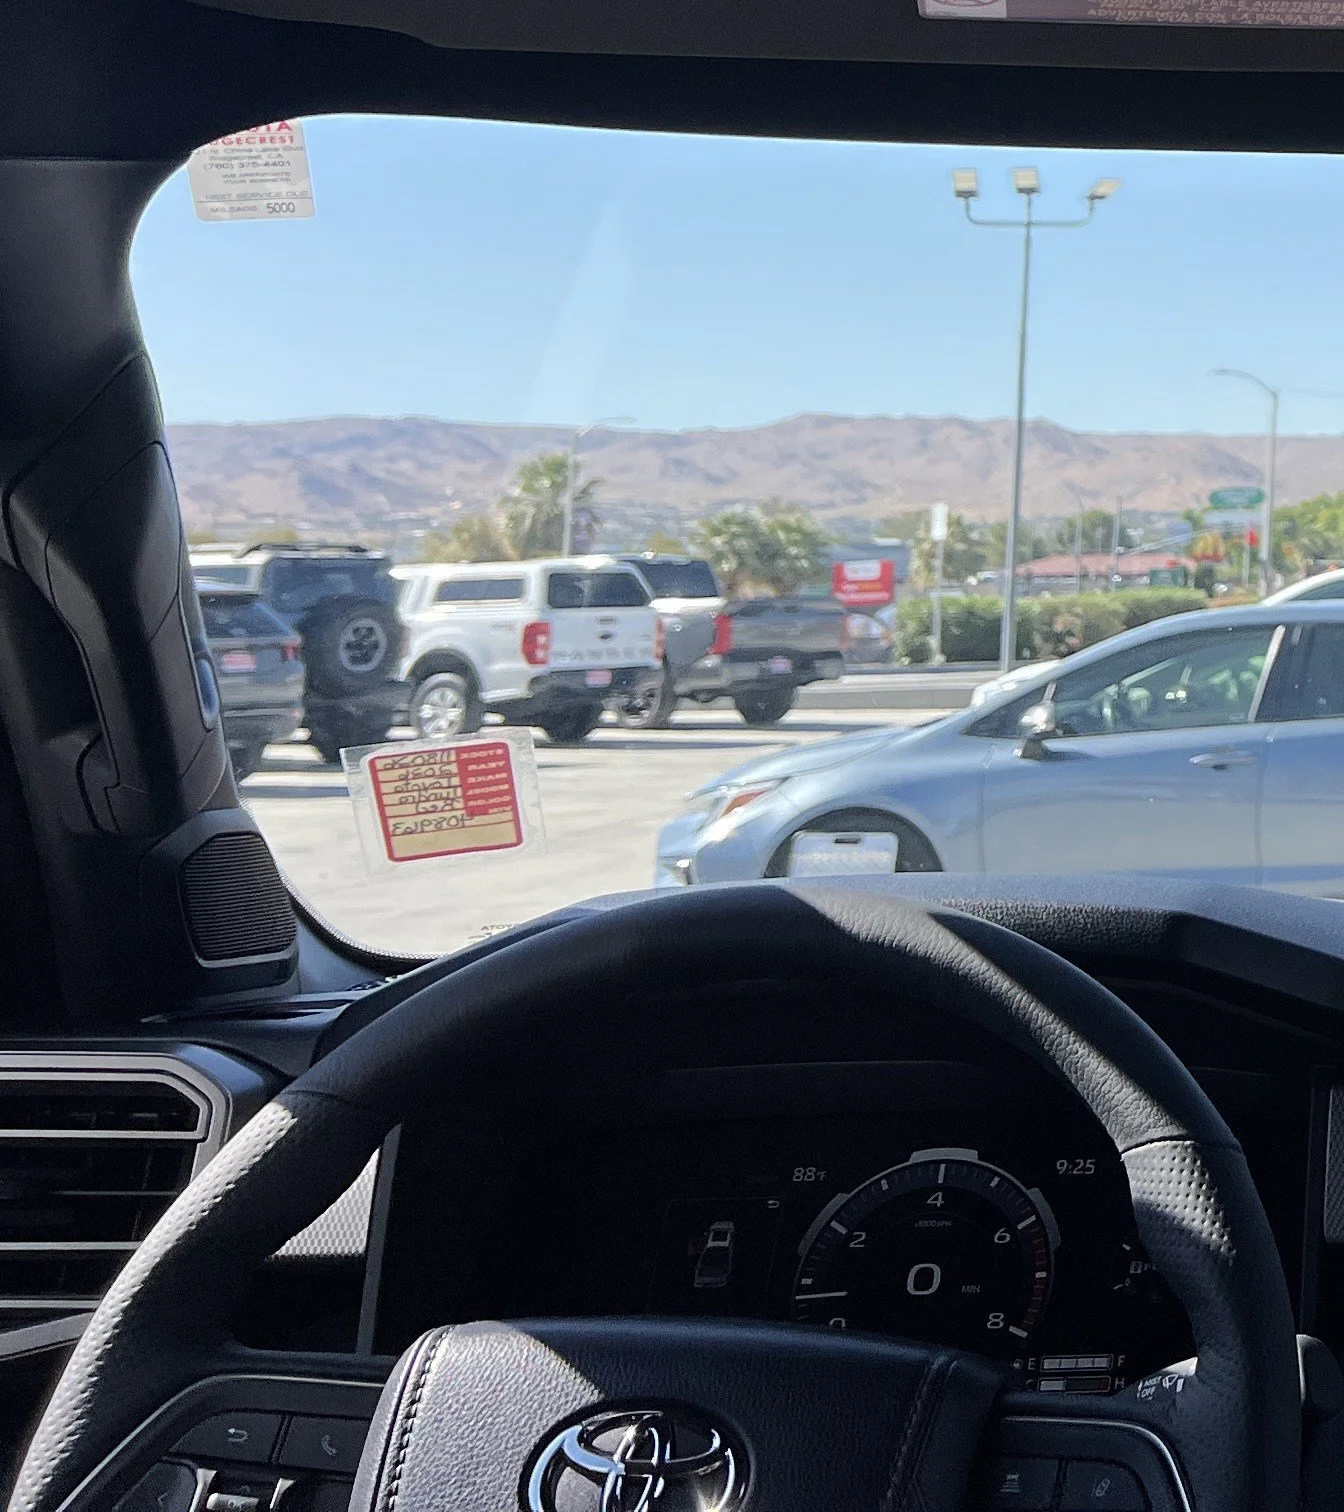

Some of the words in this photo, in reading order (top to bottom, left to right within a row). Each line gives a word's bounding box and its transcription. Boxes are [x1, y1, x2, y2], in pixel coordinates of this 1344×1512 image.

[266, 202, 296, 214] 5000
[1055, 1159, 1097, 1176] 9:25
[927, 1191, 945, 1207] 4
[850, 1232, 867, 1248] 2
[994, 1228, 1011, 1245] 6
[906, 1262, 942, 1296] 0
[986, 1312, 1004, 1330] 8
[1027, 1357, 1037, 1371] E
[1114, 1378, 1125, 1390] H
